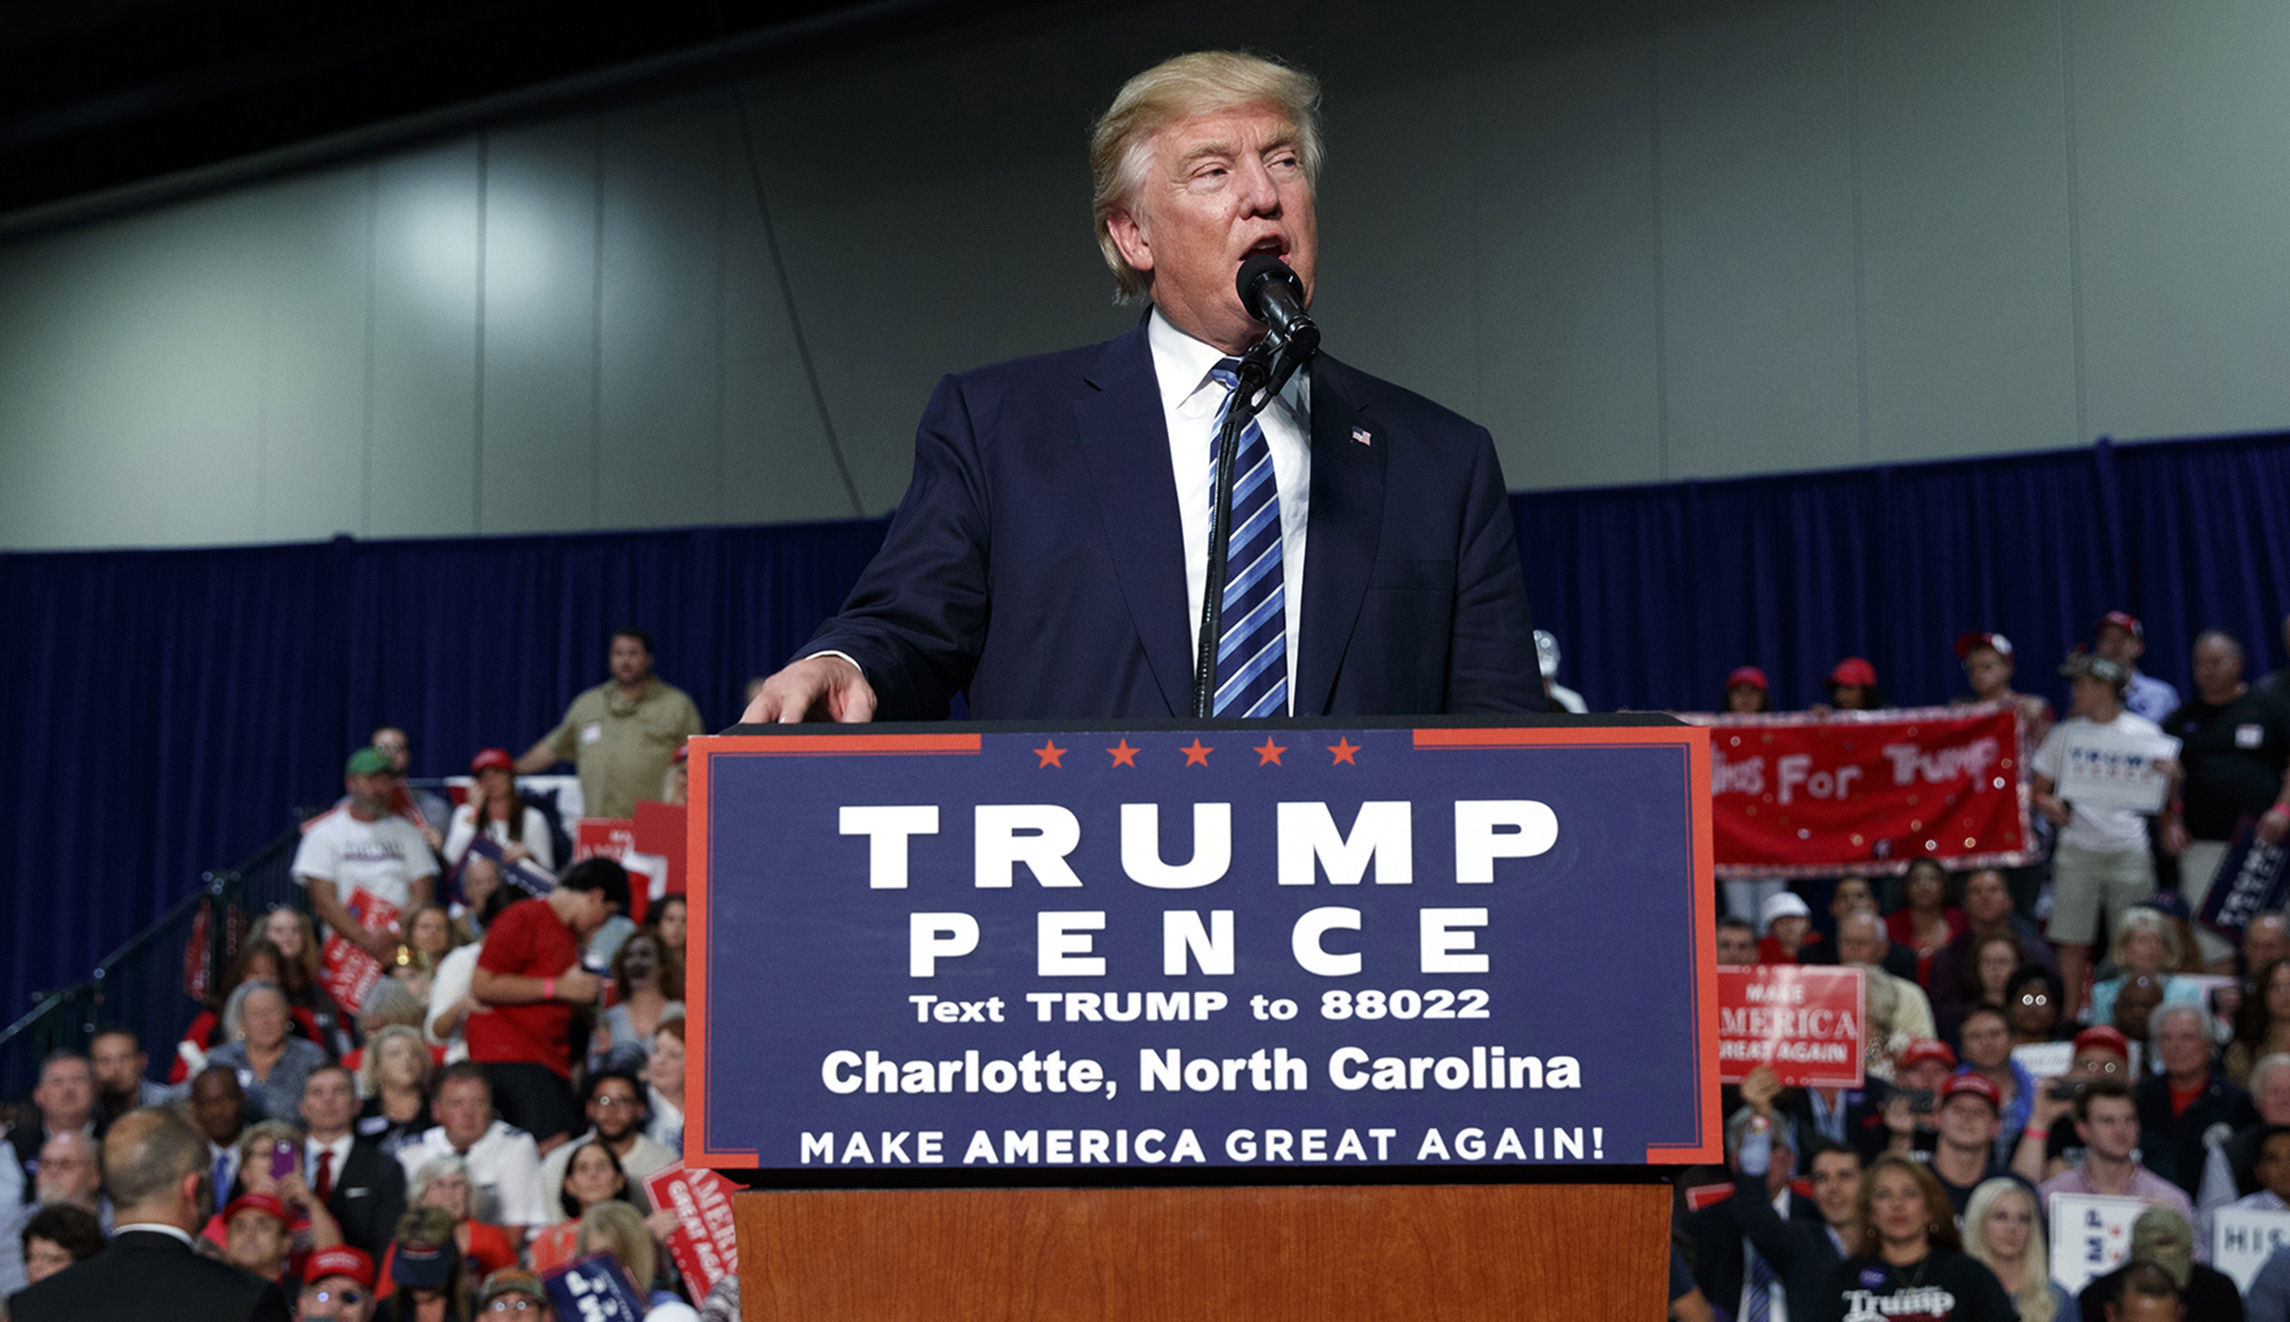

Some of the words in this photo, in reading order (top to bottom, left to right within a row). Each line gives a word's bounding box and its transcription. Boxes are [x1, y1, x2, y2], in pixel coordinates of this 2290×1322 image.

[1776, 753, 1863, 806] For
[1882, 736, 1998, 794] Trump
[838, 799, 1559, 889] TRUMP
[909, 906, 1490, 978] PENCE
[908, 994, 1005, 1023] Text
[1025, 991, 1228, 1022] TRUMP
[1249, 994, 1299, 1021] to
[1320, 988, 1490, 1020] 88022
[1745, 983, 1806, 1003] MAKE
[1719, 1006, 1857, 1040] MERICA
[821, 1049, 1117, 1100] Charlotte,
[1139, 1047, 1308, 1092] North
[1328, 1045, 1582, 1091] Carolina
[1719, 1039, 1773, 1062] REAT
[1776, 1041, 1848, 1064] AGAIN
[800, 1131, 944, 1164] MAKE
[962, 1128, 1206, 1164] AMERICA
[1225, 1128, 1397, 1162] GREAT
[1416, 1127, 1604, 1161] AGAIN!
[668, 1180, 709, 1241] GREAT
[693, 1241, 725, 1285] AGA
[2085, 1208, 2104, 1282] MP
[1842, 1289, 1955, 1318] Trump
